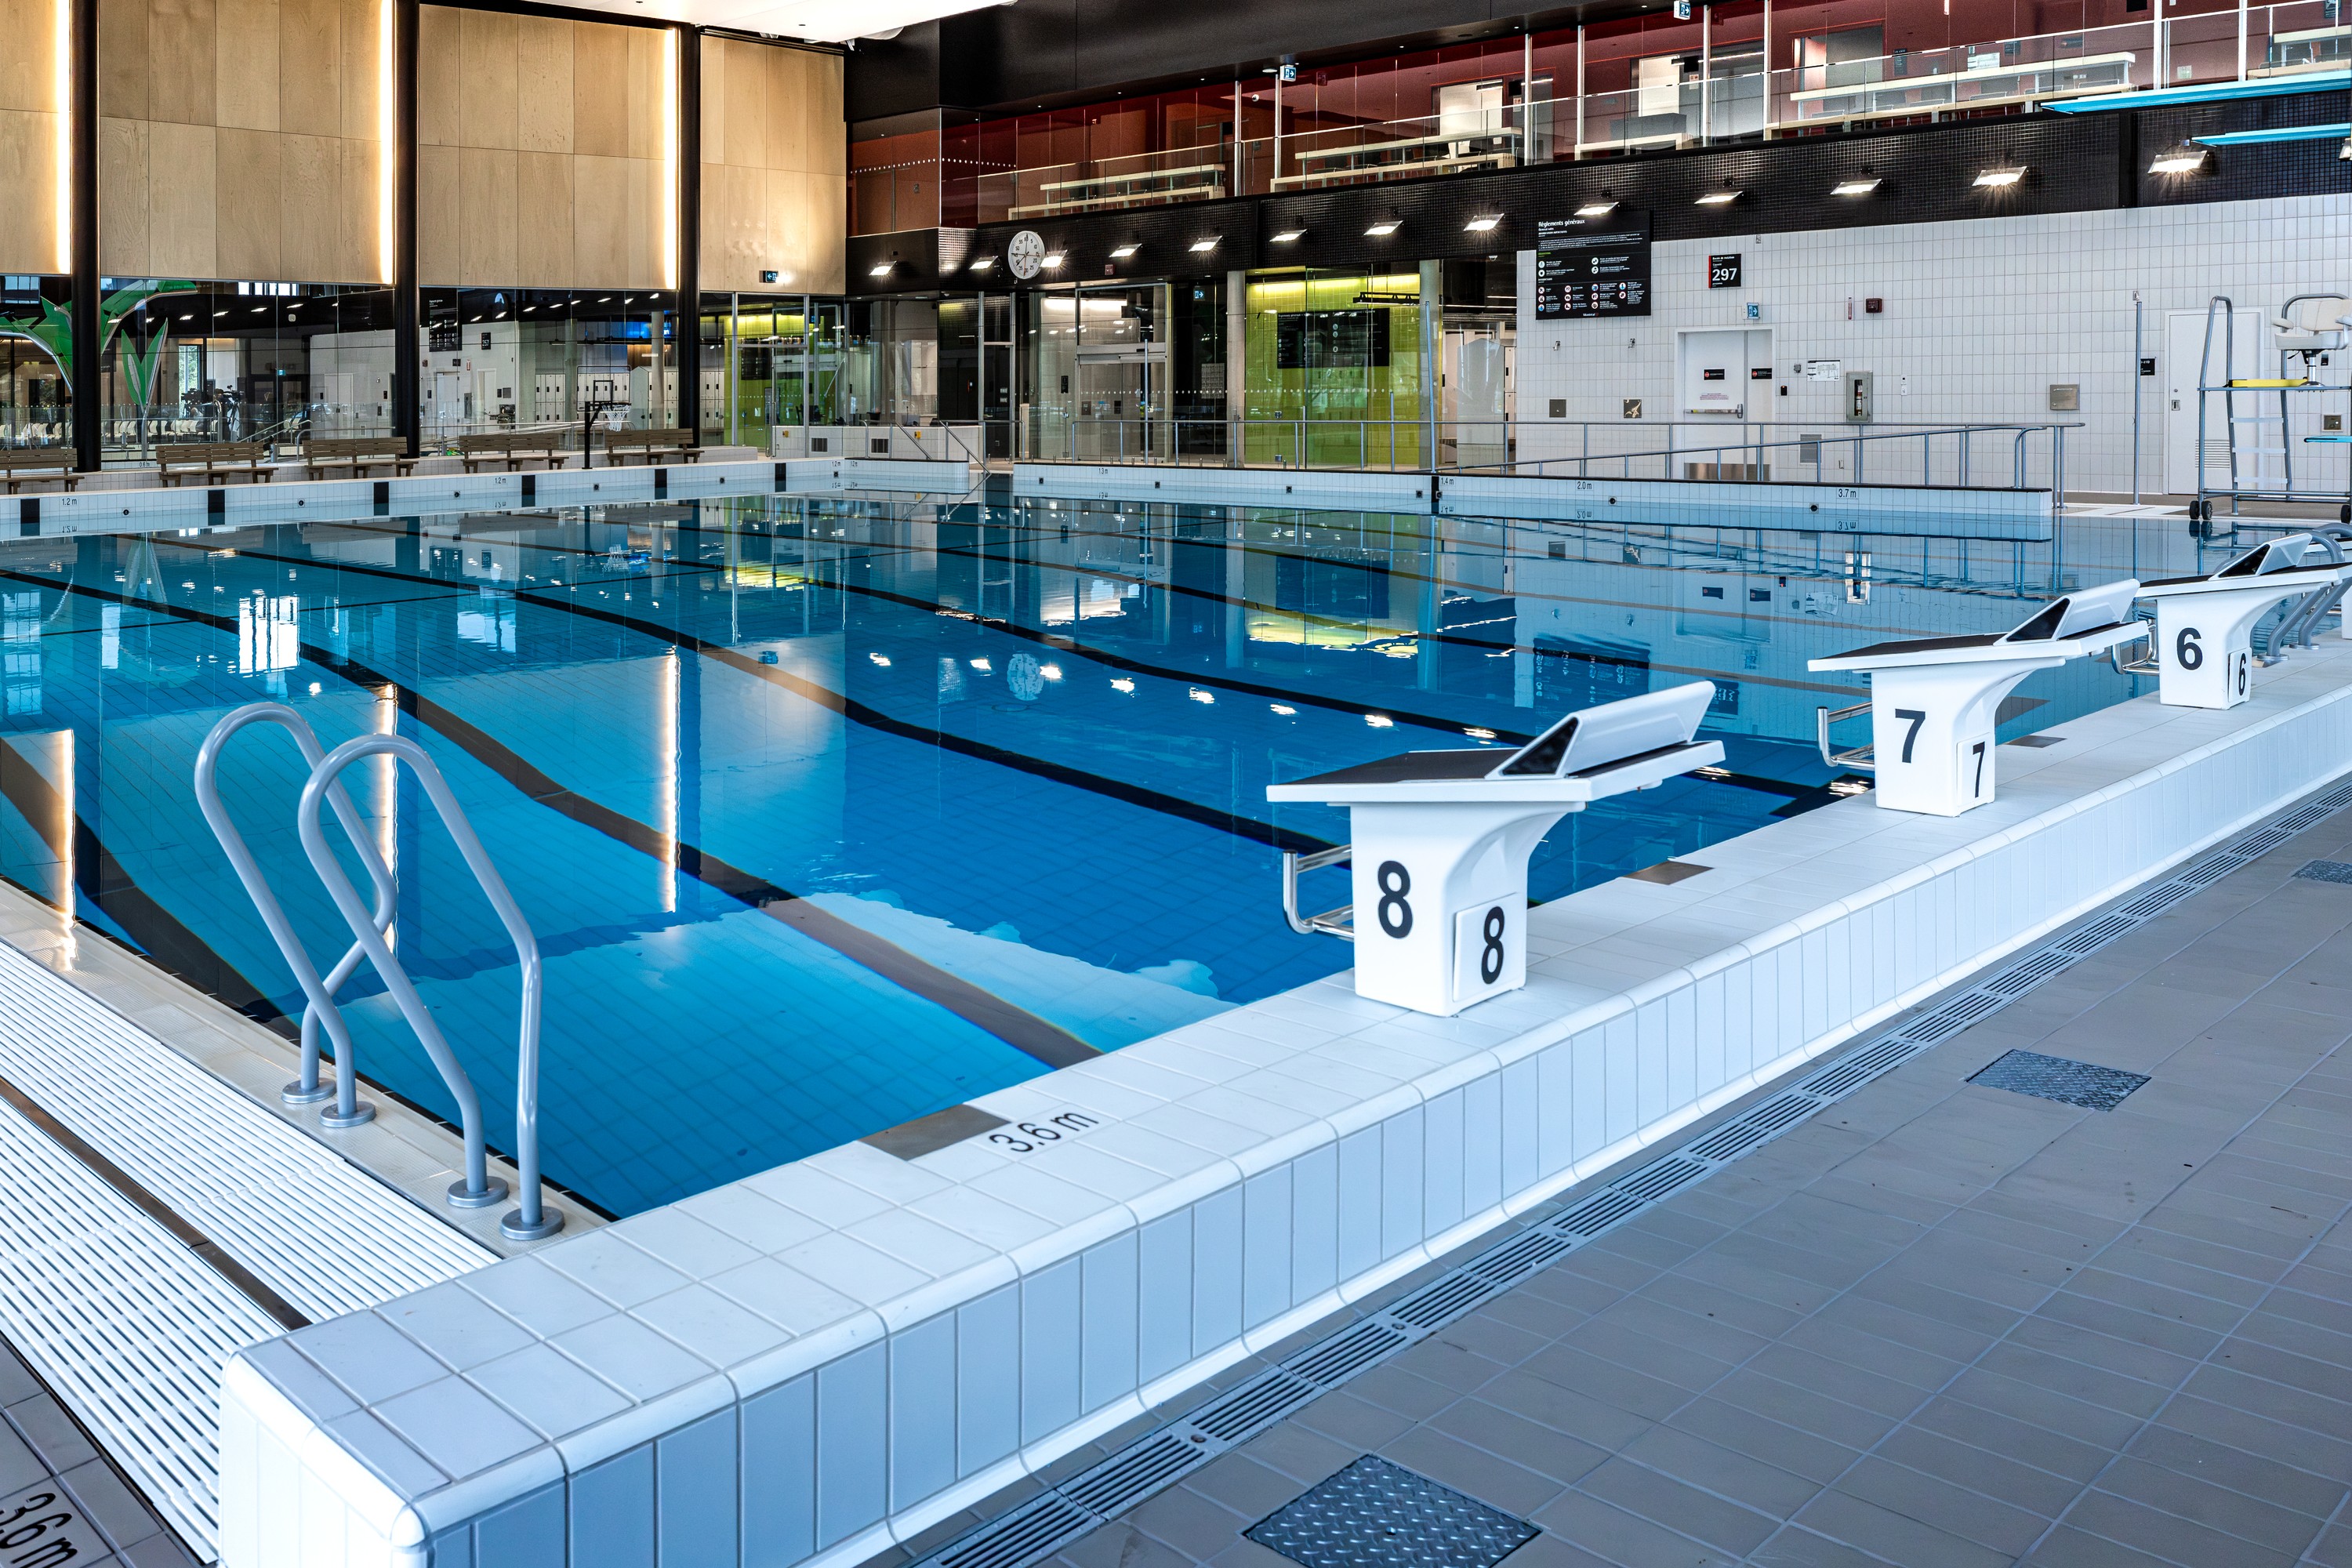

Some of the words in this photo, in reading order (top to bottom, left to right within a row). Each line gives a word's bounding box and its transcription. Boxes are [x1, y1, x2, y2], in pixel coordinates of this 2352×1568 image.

[1712, 268, 1737, 281] 297
[1838, 488, 1849, 498] 3.7
[2176, 627, 2203, 670] 6
[2238, 653, 2246, 696] 6
[1895, 708, 1926, 764] 7
[1973, 741, 1985, 798] 7
[1377, 860, 1413, 938] 8
[1481, 906, 1504, 984] 8
[989, 1123, 1062, 1152] 3.6
[1049, 1112, 1099, 1131] m
[10, 1537, 78, 1568] m
